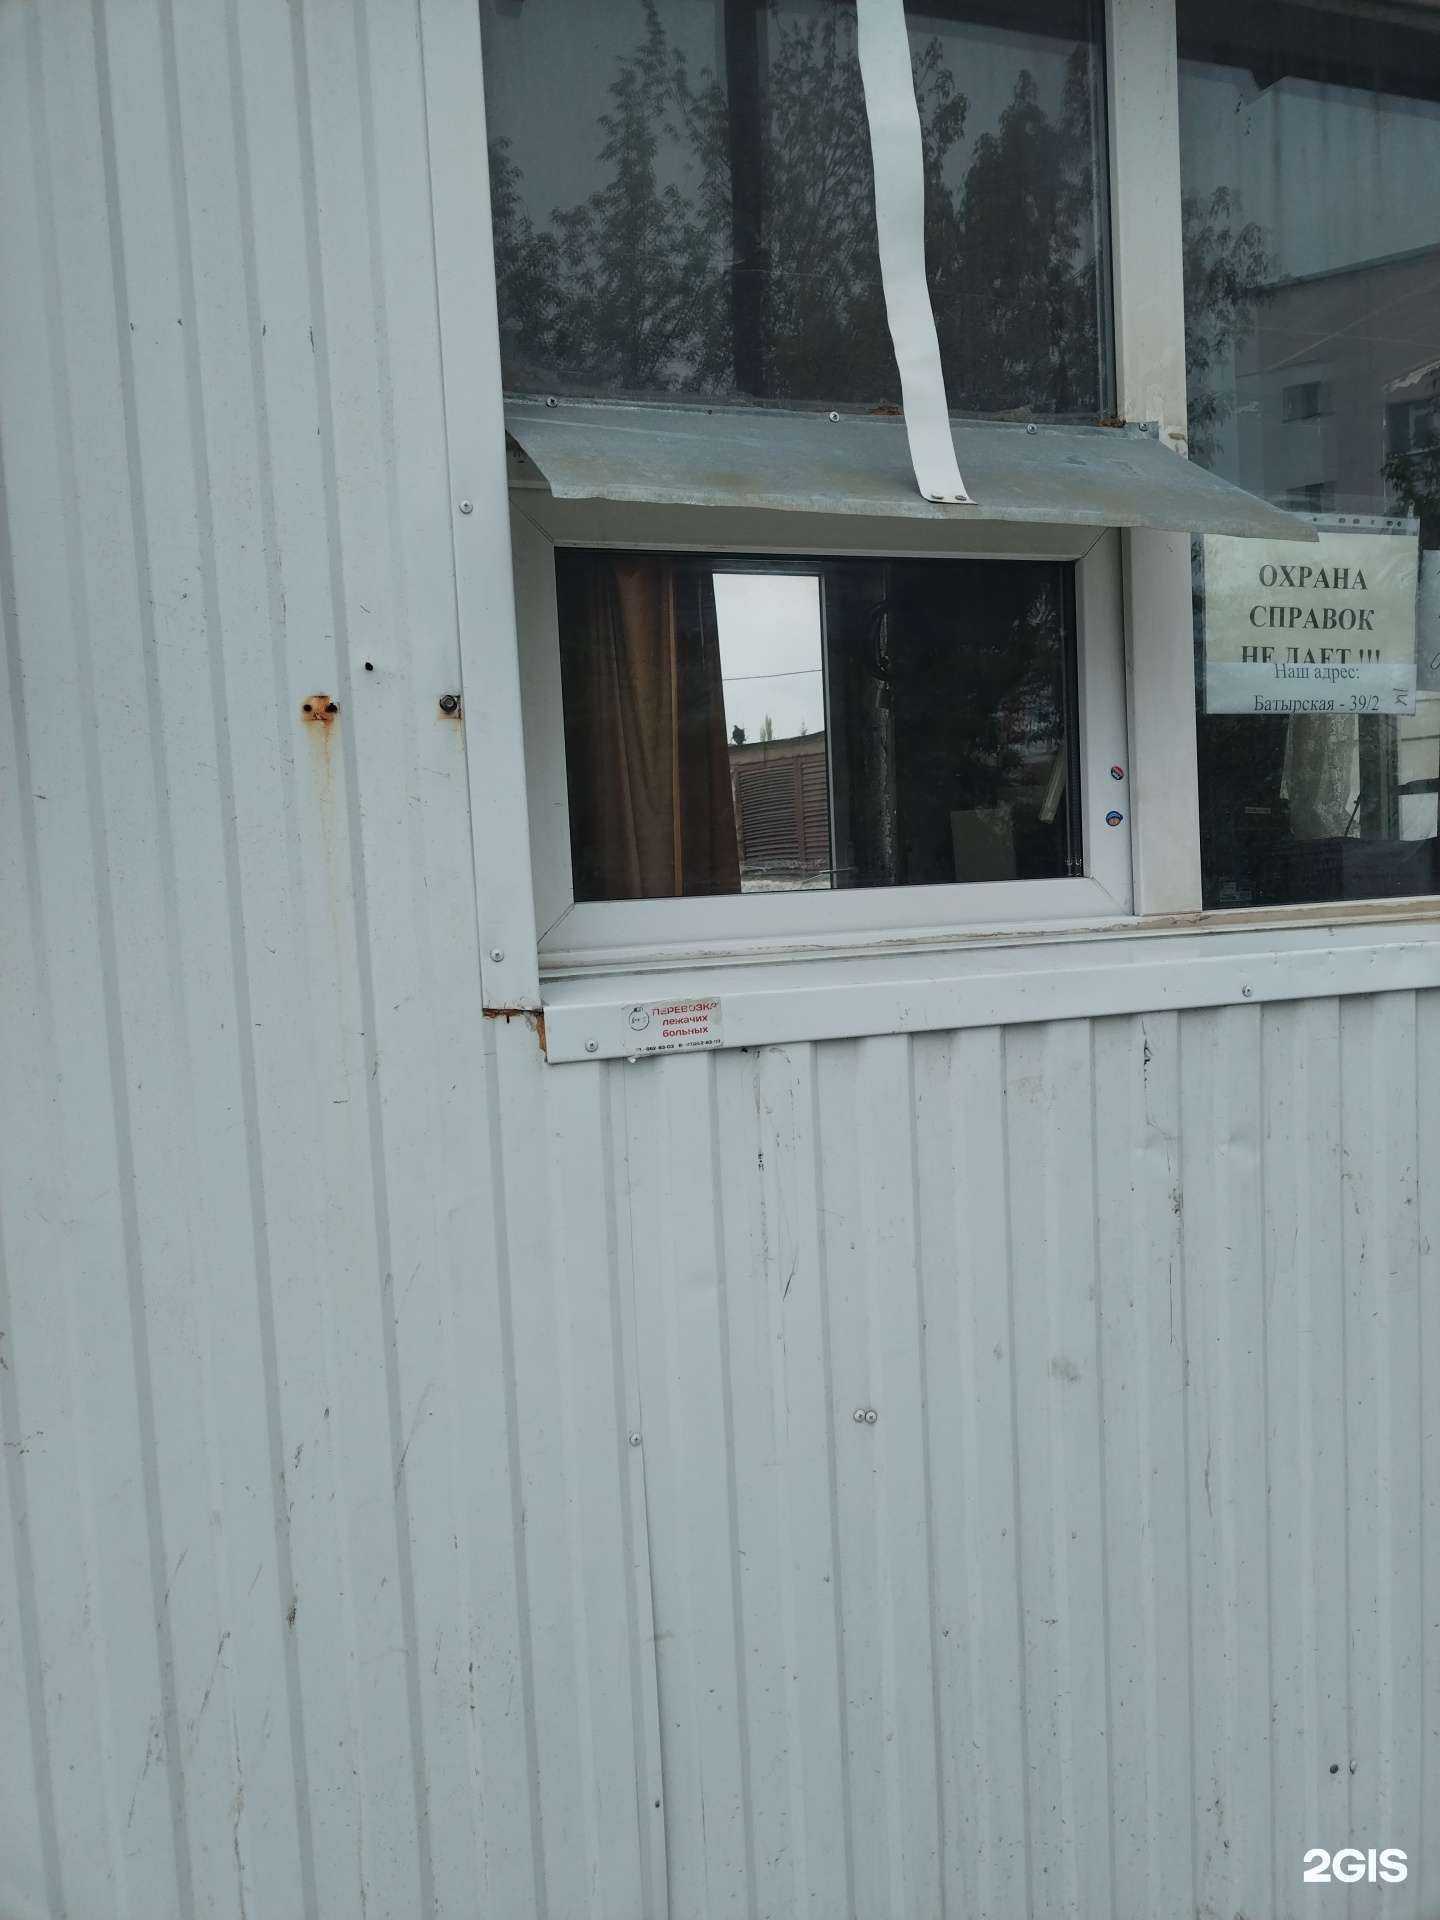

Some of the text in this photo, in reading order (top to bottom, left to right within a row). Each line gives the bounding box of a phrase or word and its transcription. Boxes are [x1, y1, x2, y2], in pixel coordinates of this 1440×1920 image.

[1258, 564, 1368, 590] ОХРАНА
[1249, 604, 1375, 631] СПРАВОК
[1274, 663, 1360, 684] Наш адрес:
[1254, 694, 1335, 713] Батырская
[1349, 694, 1381, 712] 39/2
[662, 1015, 708, 1026] лежачих
[662, 1027, 709, 1038] больных
